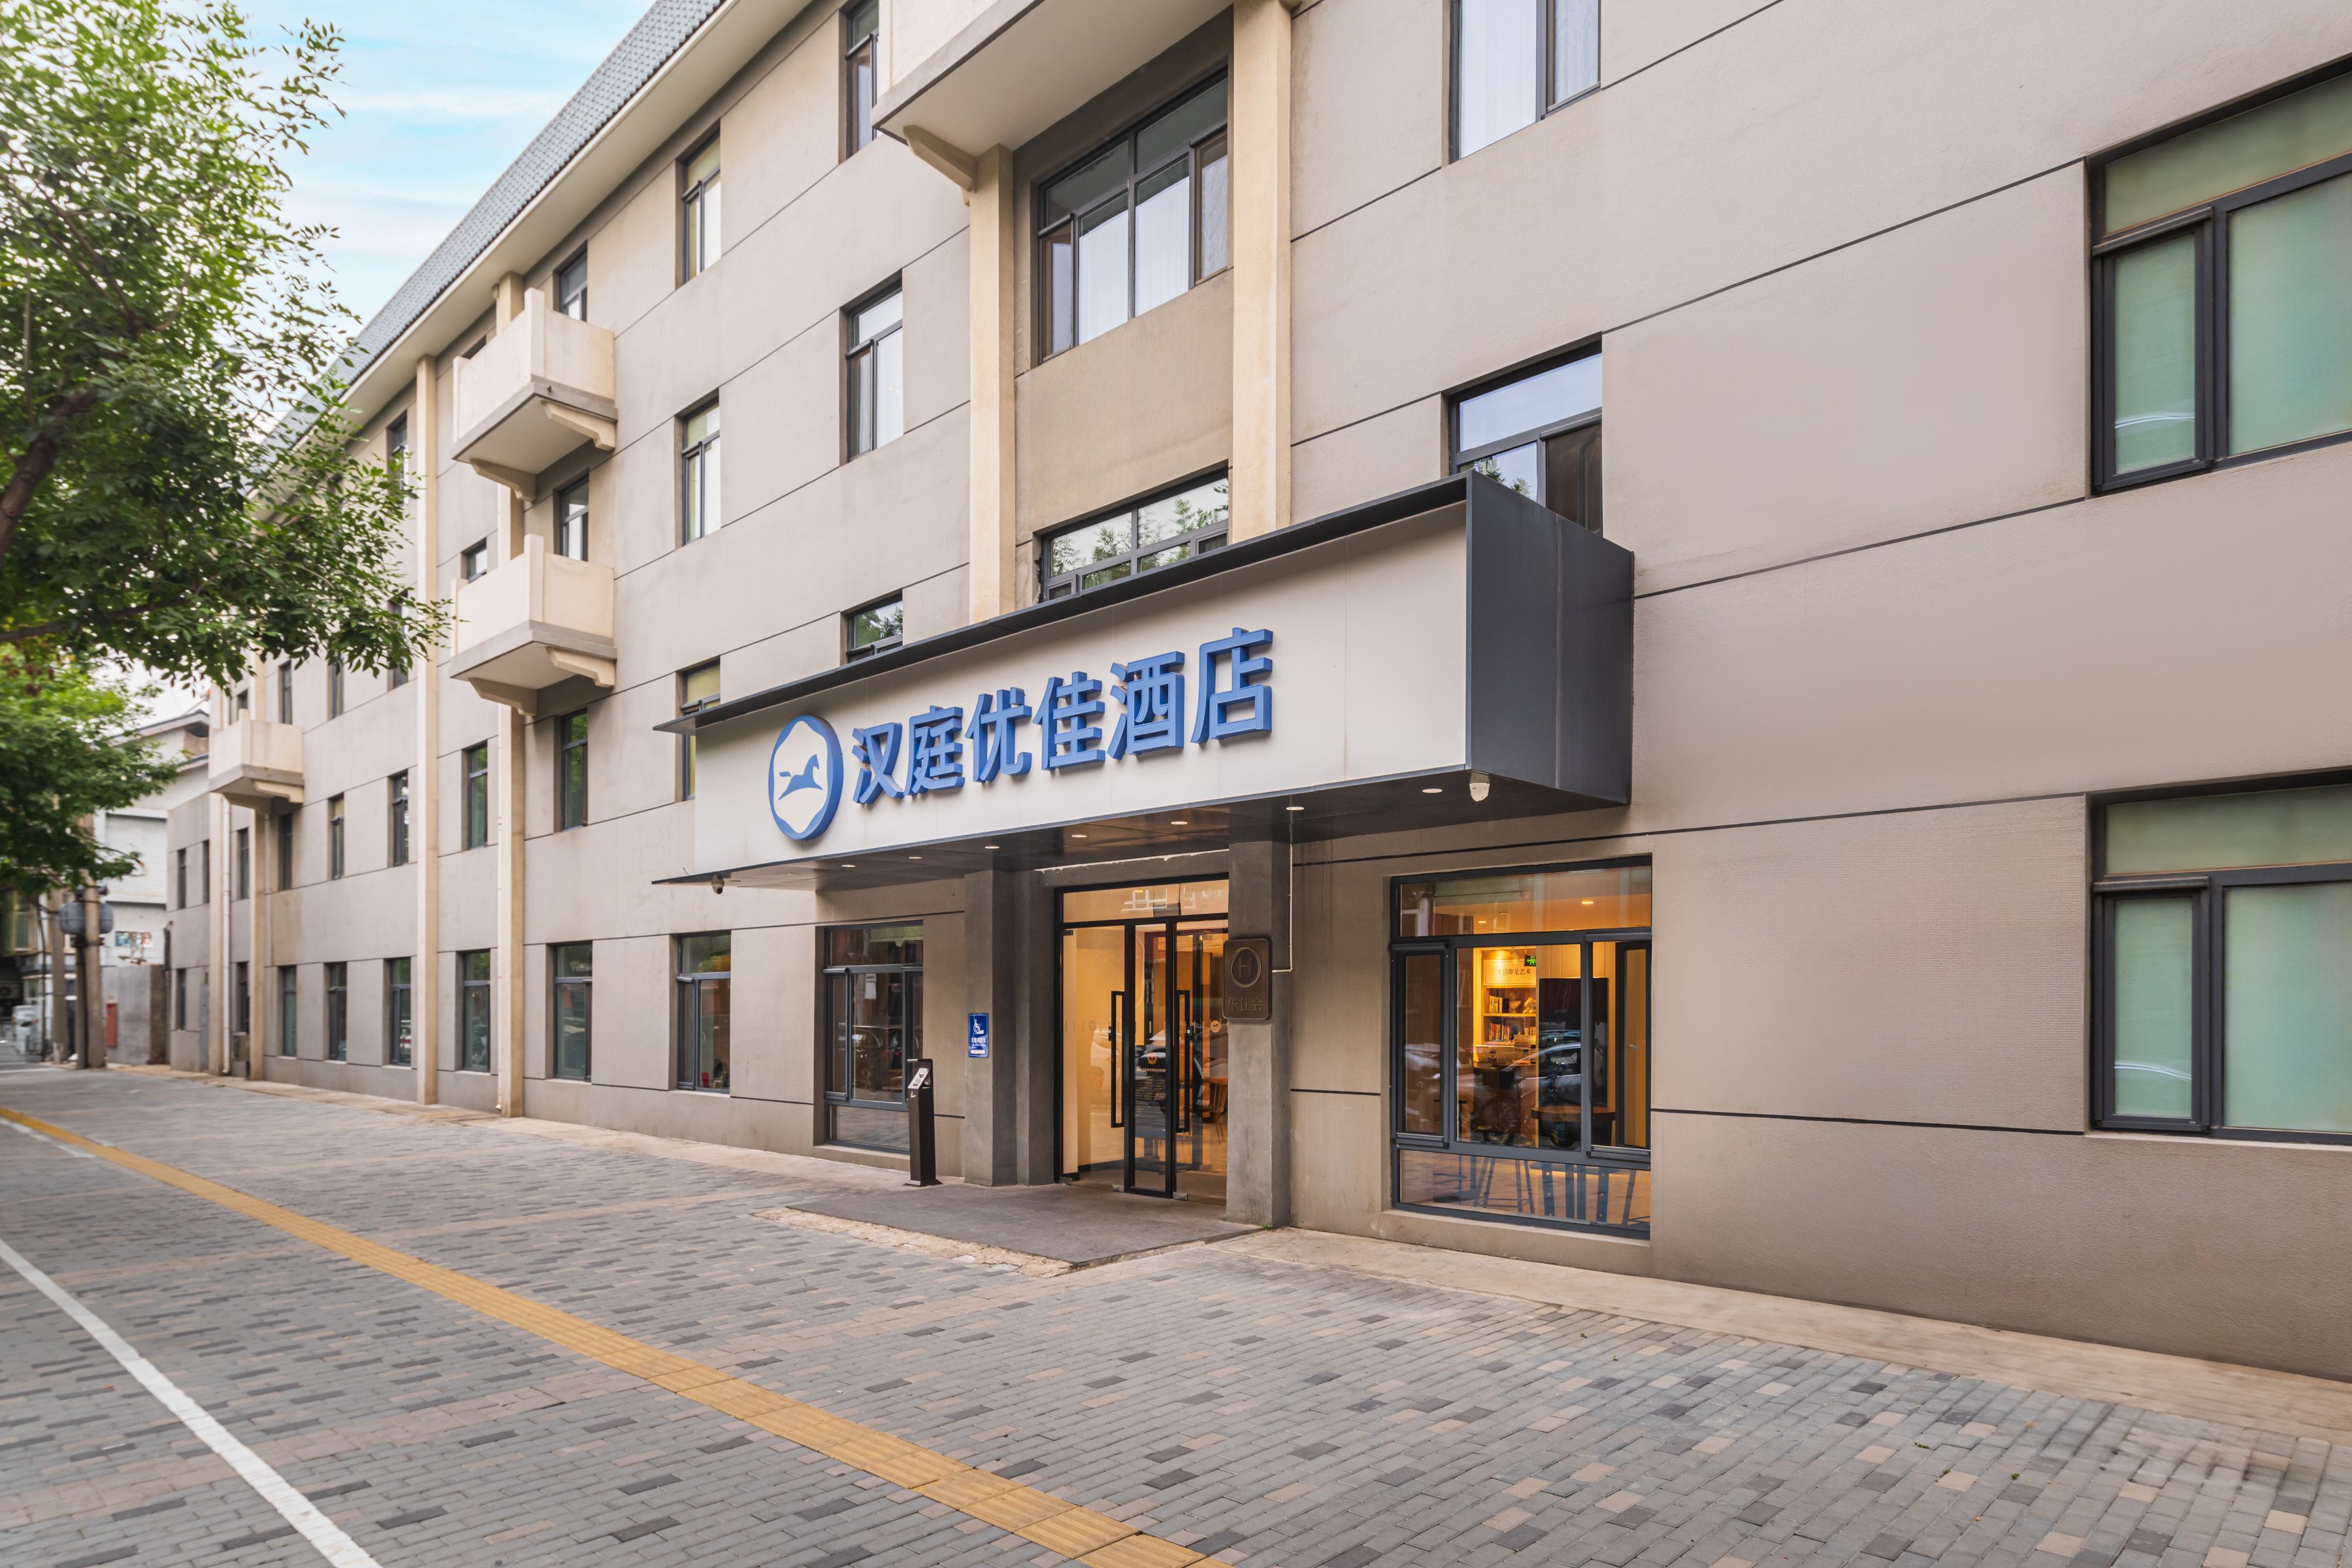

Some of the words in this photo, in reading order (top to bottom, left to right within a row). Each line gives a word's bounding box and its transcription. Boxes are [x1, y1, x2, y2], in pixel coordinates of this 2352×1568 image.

[852, 627, 1273, 805] 汉庭优佳酒店
[1228, 996, 1264, 1012] 华住会
